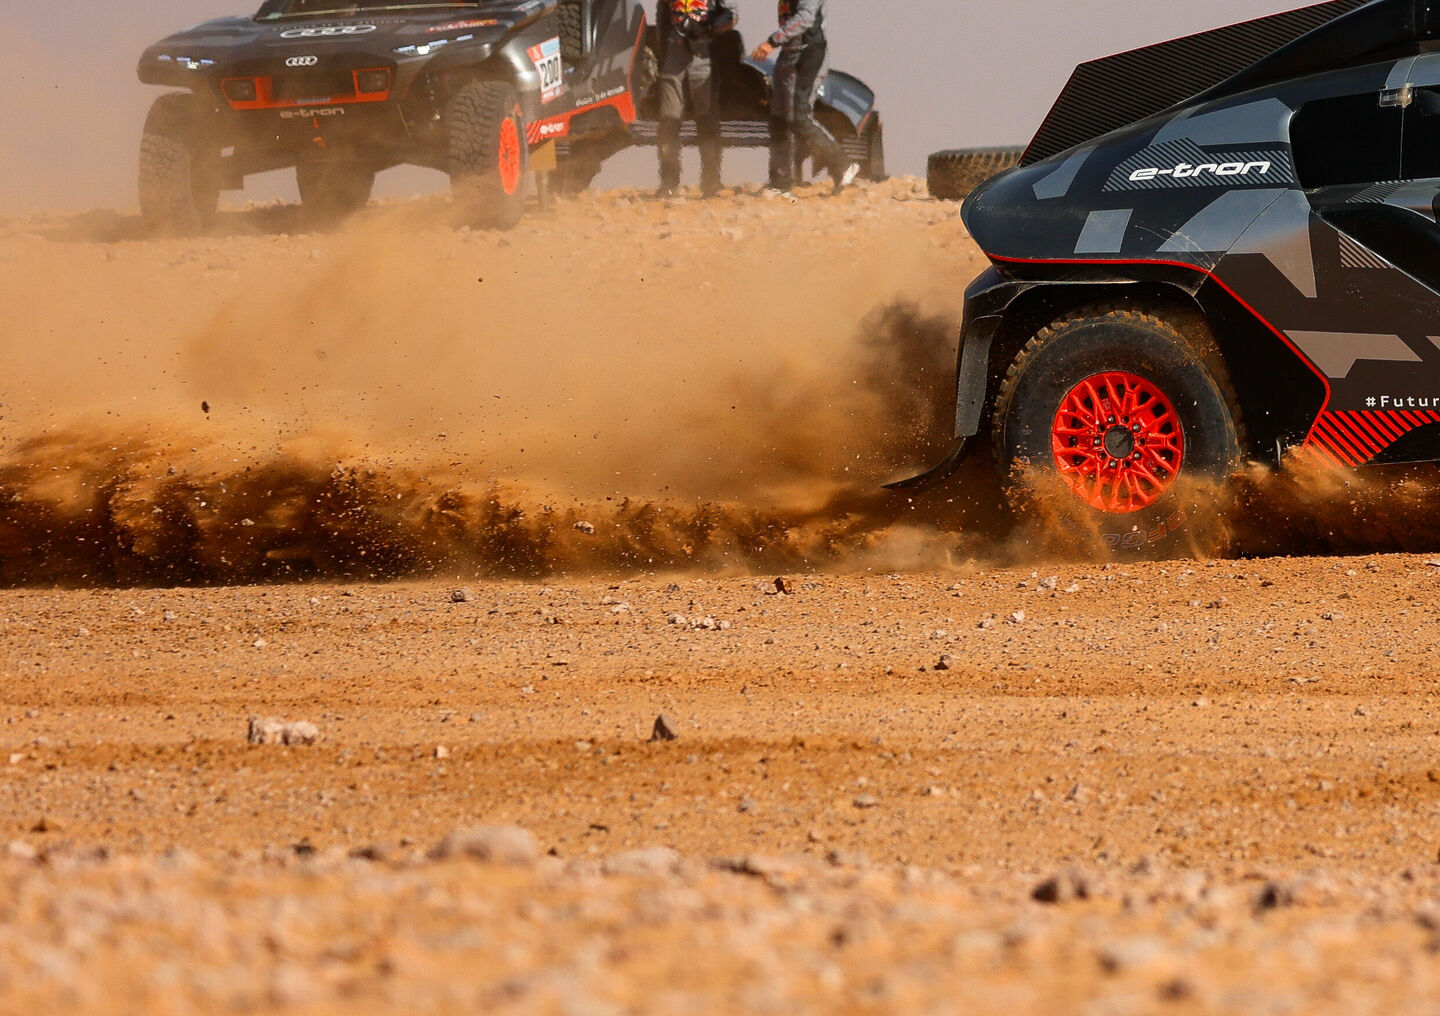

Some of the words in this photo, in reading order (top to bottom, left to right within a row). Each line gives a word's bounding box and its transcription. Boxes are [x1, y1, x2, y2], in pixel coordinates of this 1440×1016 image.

[540, 56, 559, 88] 200
[280, 107, 345, 119] e-tron
[1128, 161, 1271, 182] e-tron
